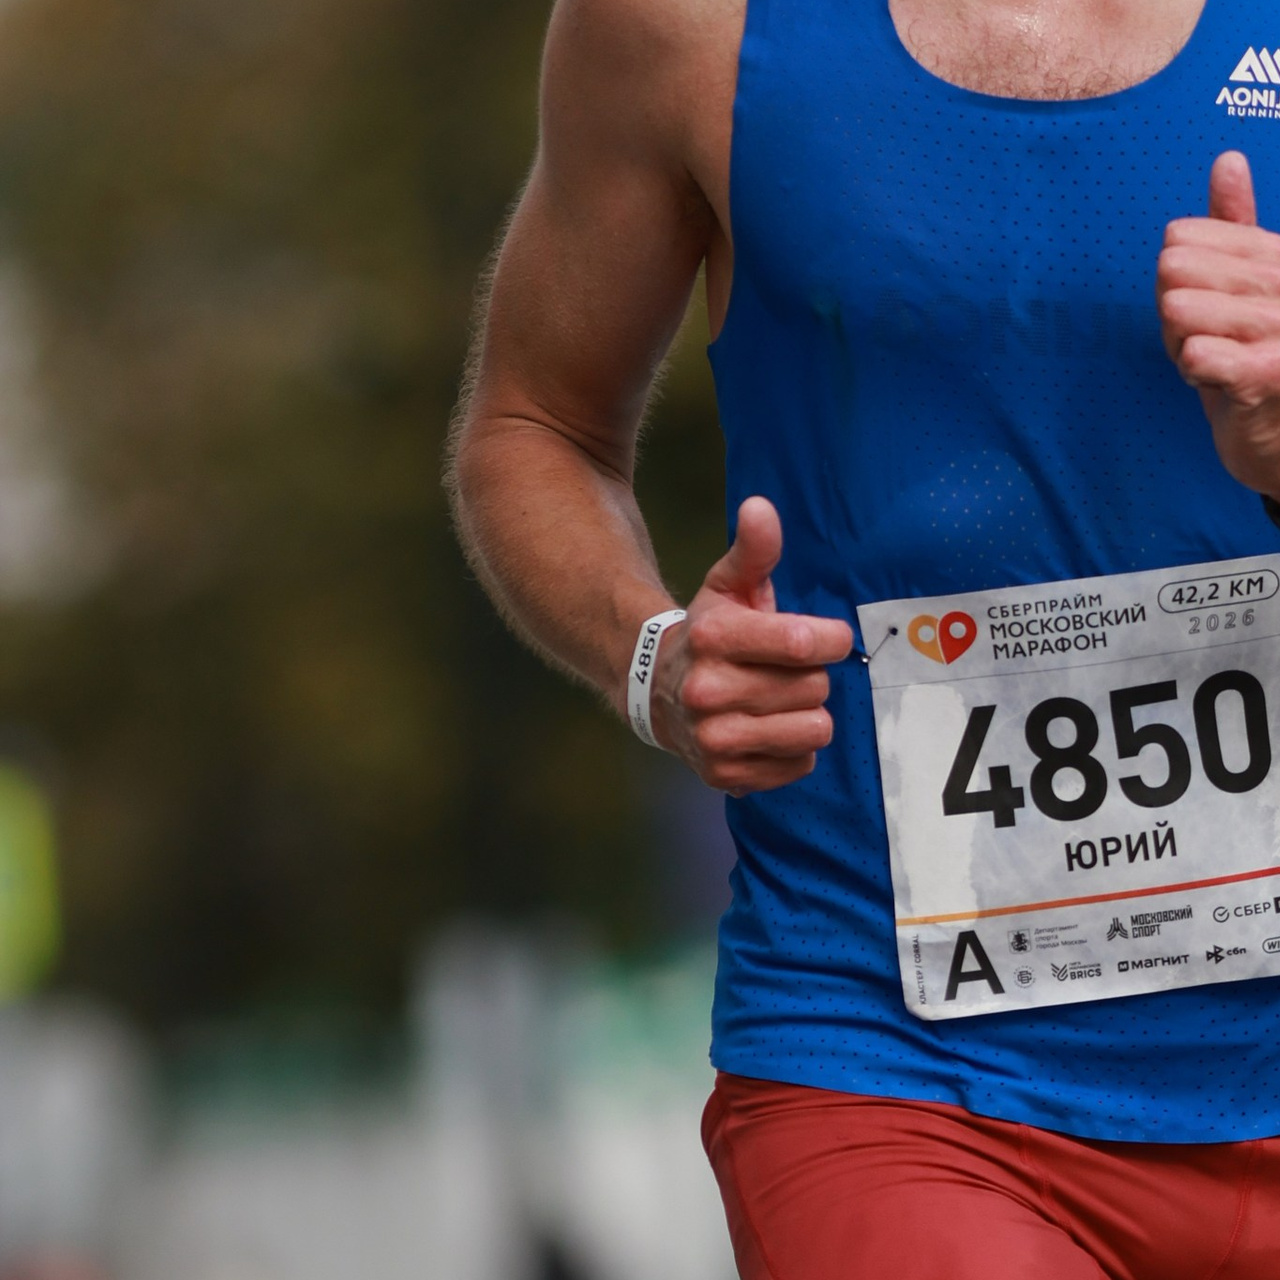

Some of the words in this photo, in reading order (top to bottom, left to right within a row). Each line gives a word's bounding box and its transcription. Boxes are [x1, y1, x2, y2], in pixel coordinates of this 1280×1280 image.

[987, 593, 1102, 619] СБЕРПРАЙМ
[1171, 583, 1220, 605] 42,2
[989, 603, 1146, 640] МОСКОВСКИЙ
[1188, 609, 1255, 635] 2026
[635, 622, 662, 685] 4850
[992, 632, 1107, 660] МАРАФОН
[942, 670, 1272, 828] 4850
[1065, 820, 1178, 871] ЮРИЙ
[1130, 905, 1193, 926] МОСКОВСКИЙ
[1233, 902, 1271, 917] СБЕР
[1131, 924, 1161, 939] СПОРТ
[1226, 947, 1247, 956] сбп
[1069, 968, 1102, 980] BRICS
[916, 970, 926, 1005] КЛАСТЕР
